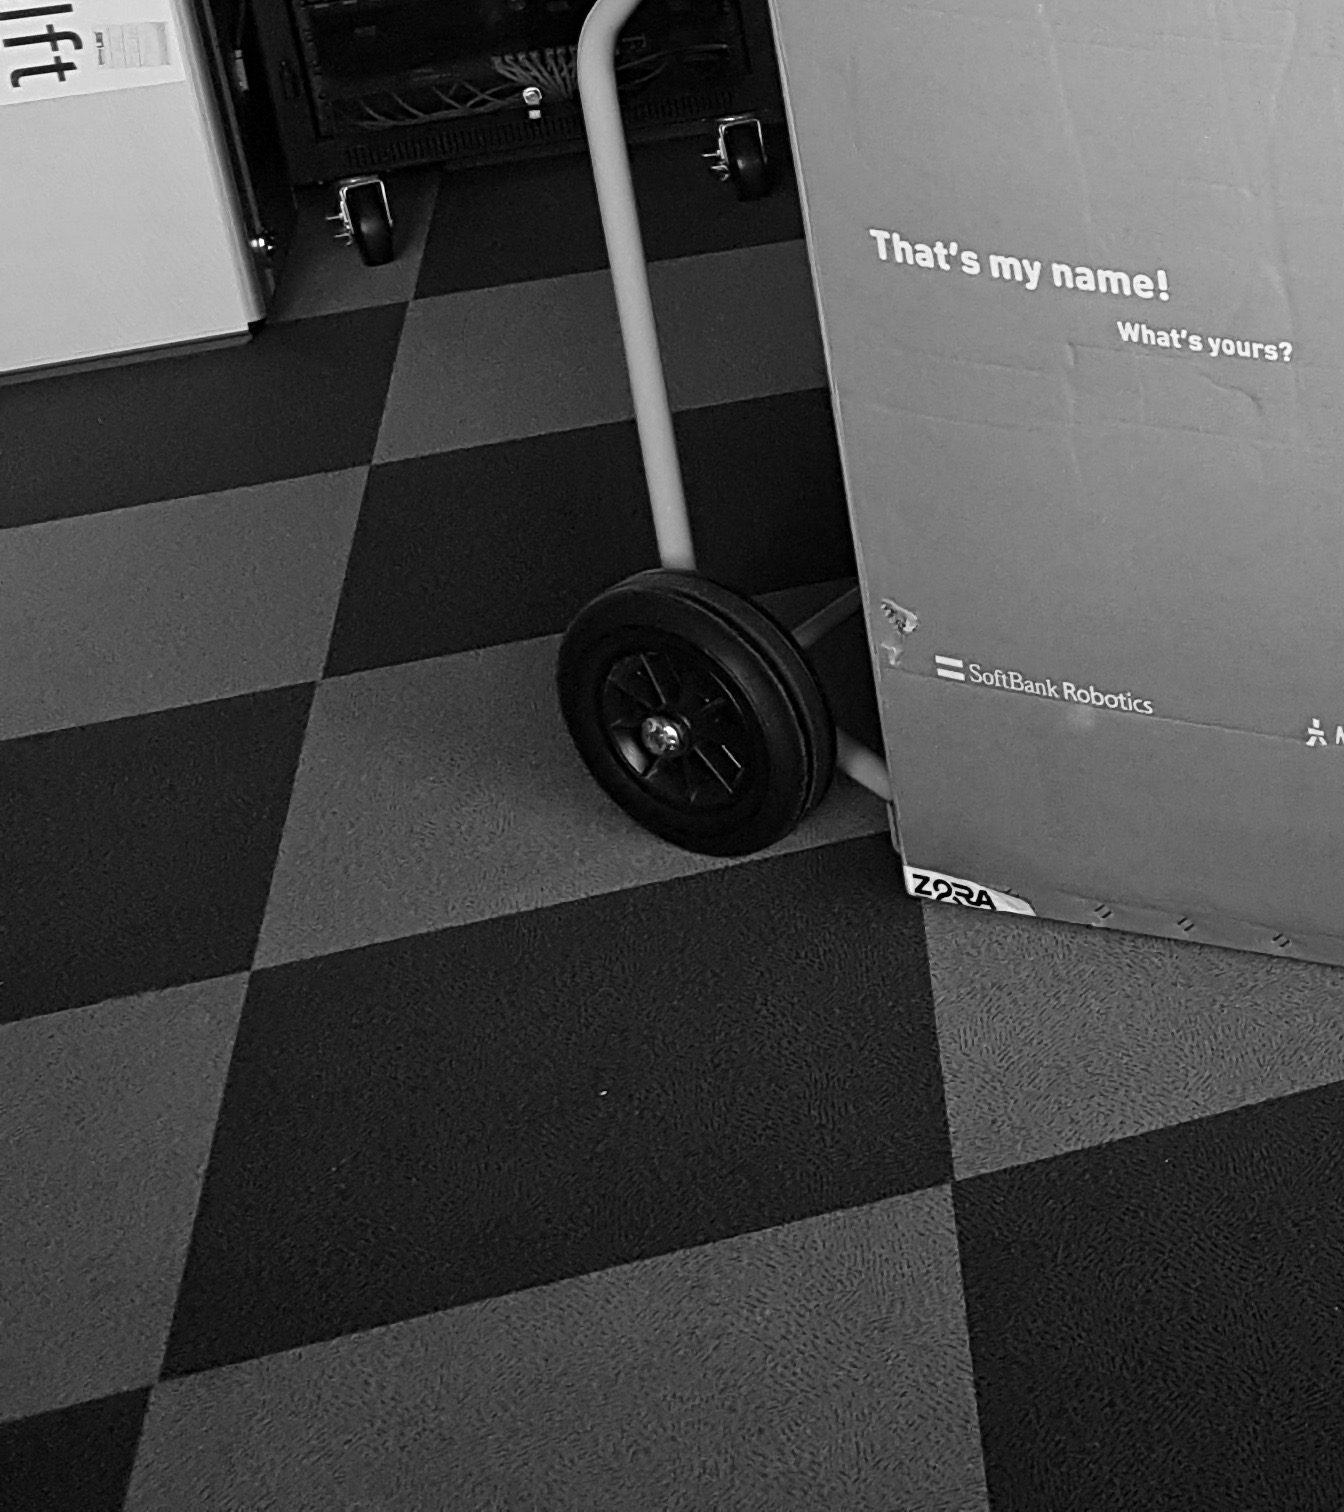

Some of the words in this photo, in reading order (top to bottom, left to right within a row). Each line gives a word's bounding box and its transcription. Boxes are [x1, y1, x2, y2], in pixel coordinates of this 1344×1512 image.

[869, 229, 981, 275] That's
[989, 253, 1042, 290] my
[1051, 262, 1171, 302] name!
[1116, 321, 1203, 352] What's
[1207, 335, 1293, 363] yours?
[968, 663, 1060, 699] SoftBank
[1062, 681, 1154, 715] Robotics
